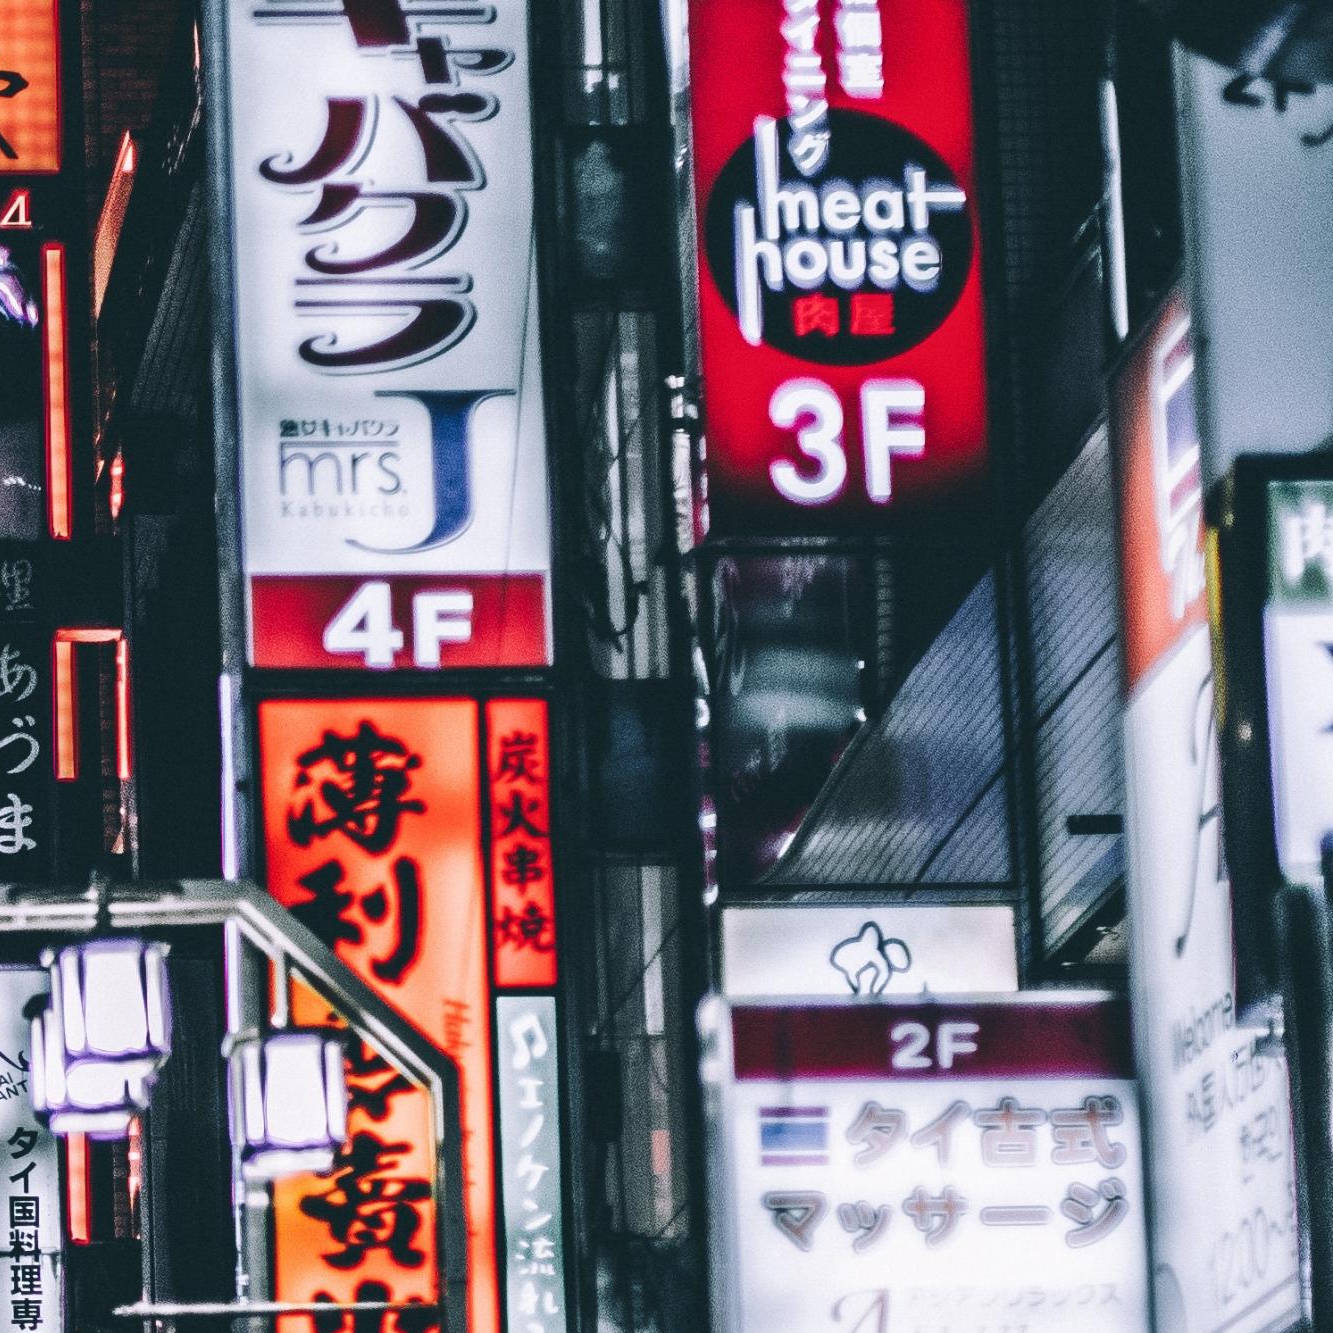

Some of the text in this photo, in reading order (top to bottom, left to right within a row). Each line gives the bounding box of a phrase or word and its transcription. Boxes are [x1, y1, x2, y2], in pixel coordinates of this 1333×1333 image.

[753, 113, 967, 239] meat
[734, 200, 944, 346] house
[768, 377, 927, 505] 3F
[322, 581, 475, 668] 4F
[889, 1021, 981, 1071] 2F
[845, 1096, 1128, 1170] タイ古式
[761, 1177, 1131, 1254] マッサージ
